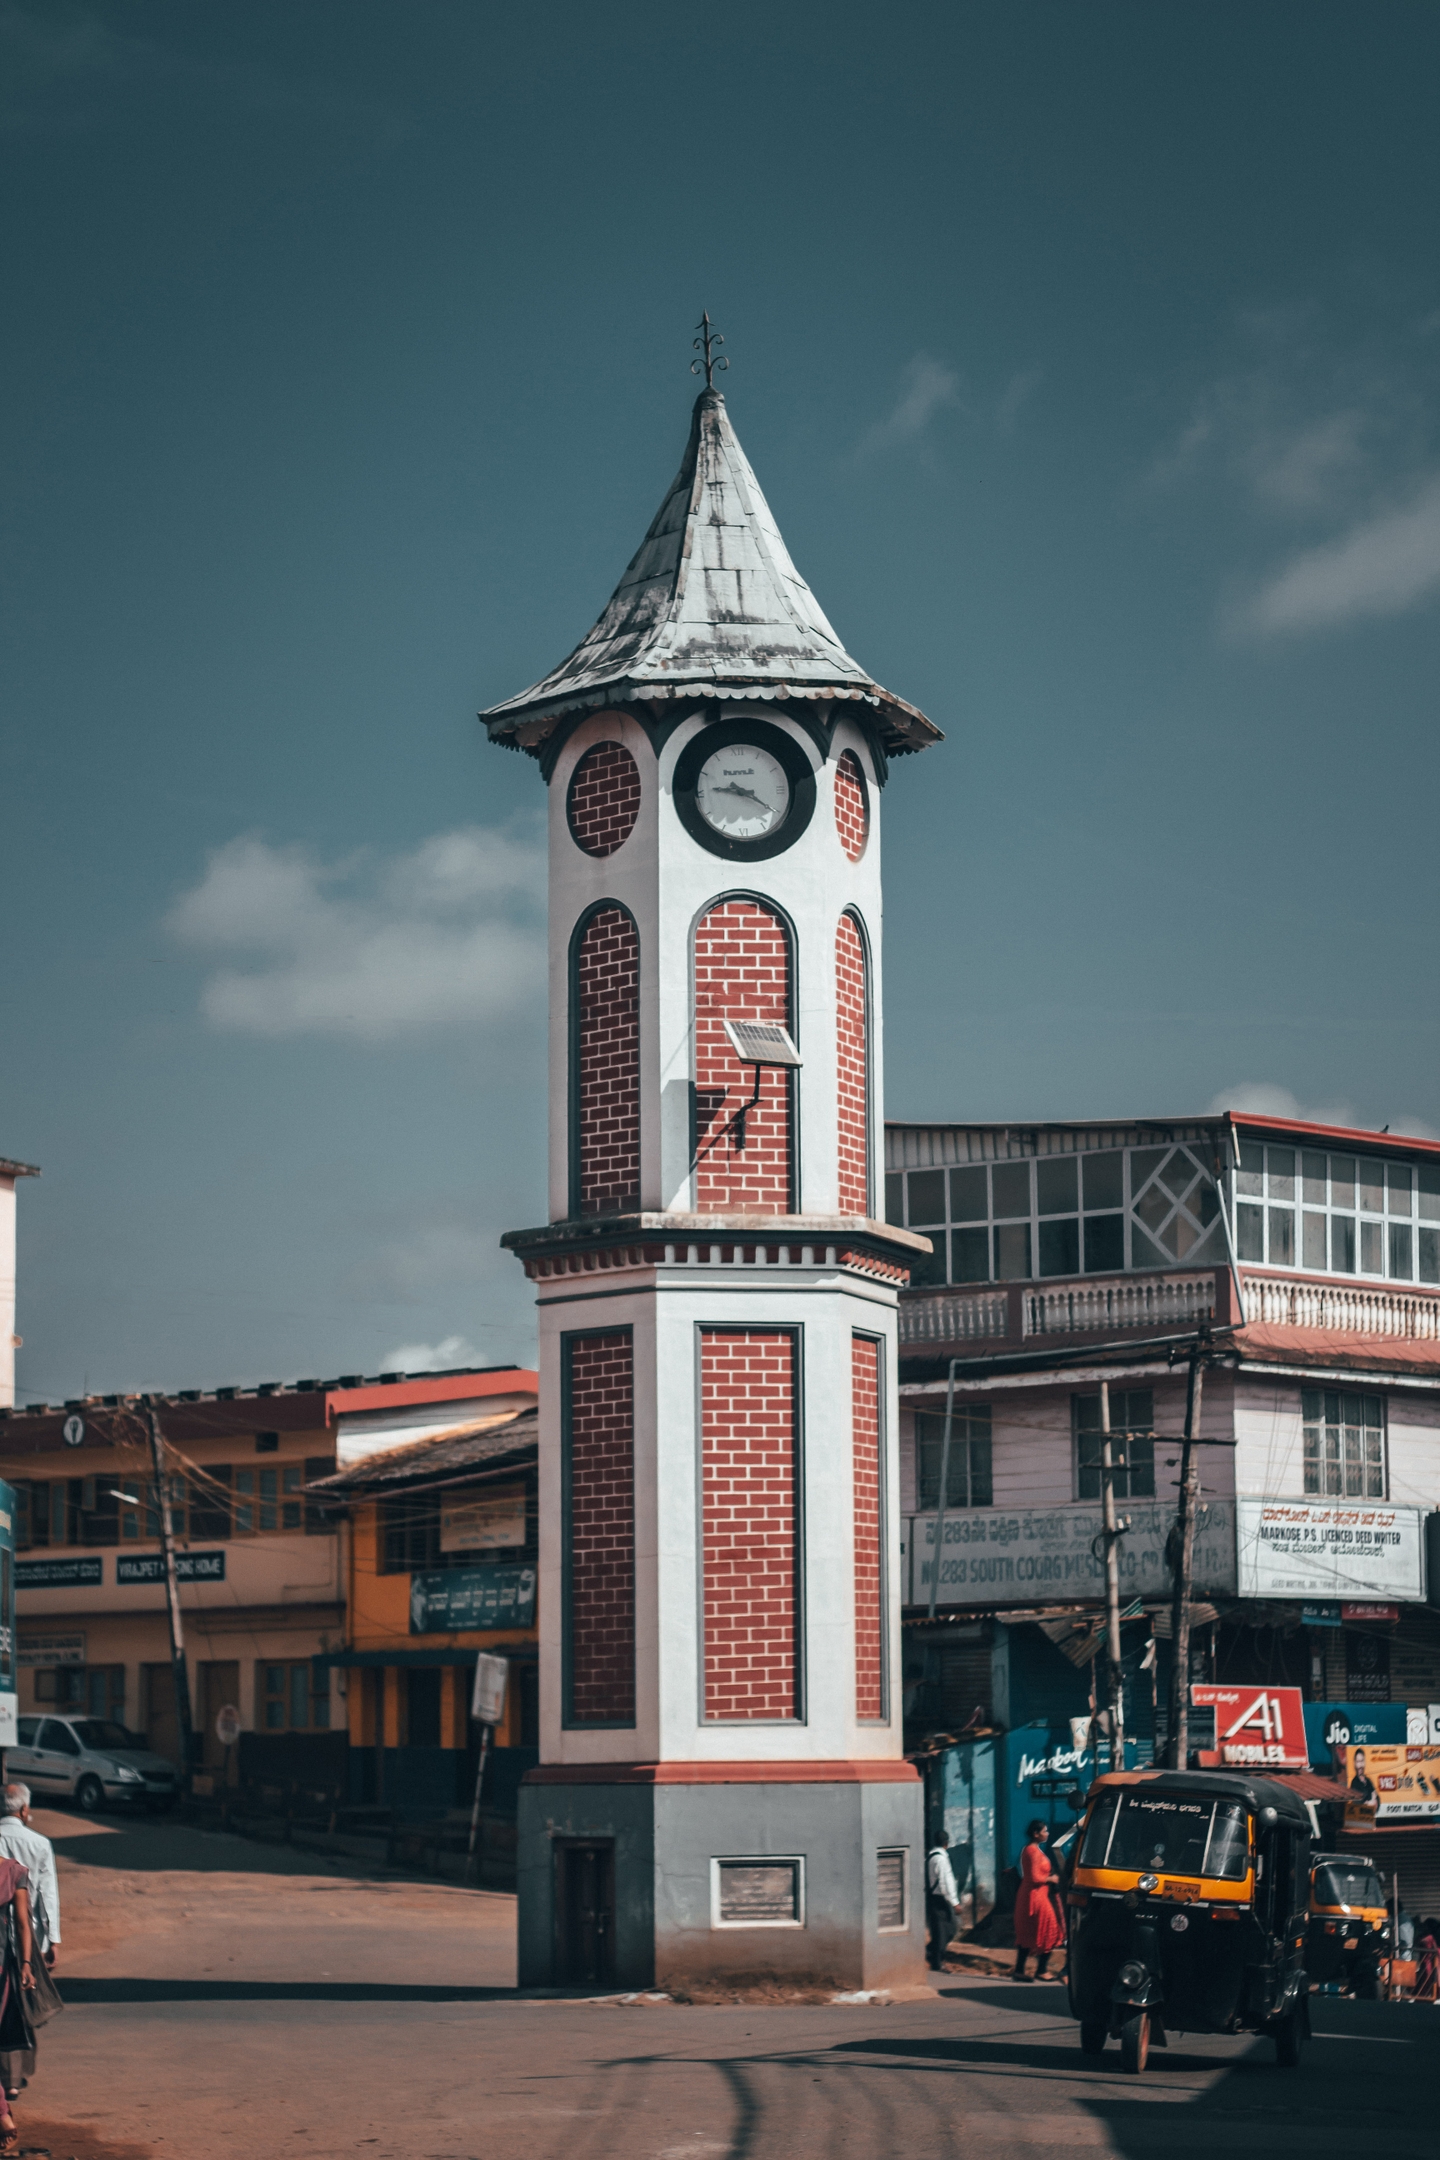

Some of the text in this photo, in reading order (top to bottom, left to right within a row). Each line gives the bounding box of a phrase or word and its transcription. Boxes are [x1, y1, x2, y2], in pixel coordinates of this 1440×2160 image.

[1261, 1526, 1301, 1541] MARKOSE
[1321, 1529, 1354, 1544] LICENCED
[1356, 1530, 1372, 1544] DEED
[1374, 1531, 1402, 1545] WRITER
[196, 1558, 220, 1574] HOME
[1326, 1720, 1350, 1744] Jio
[1354, 1724, 1378, 1734] DIGITAL
[1354, 1734, 1367, 1744] LIFE
[1223, 1744, 1286, 1764] MOBILES
